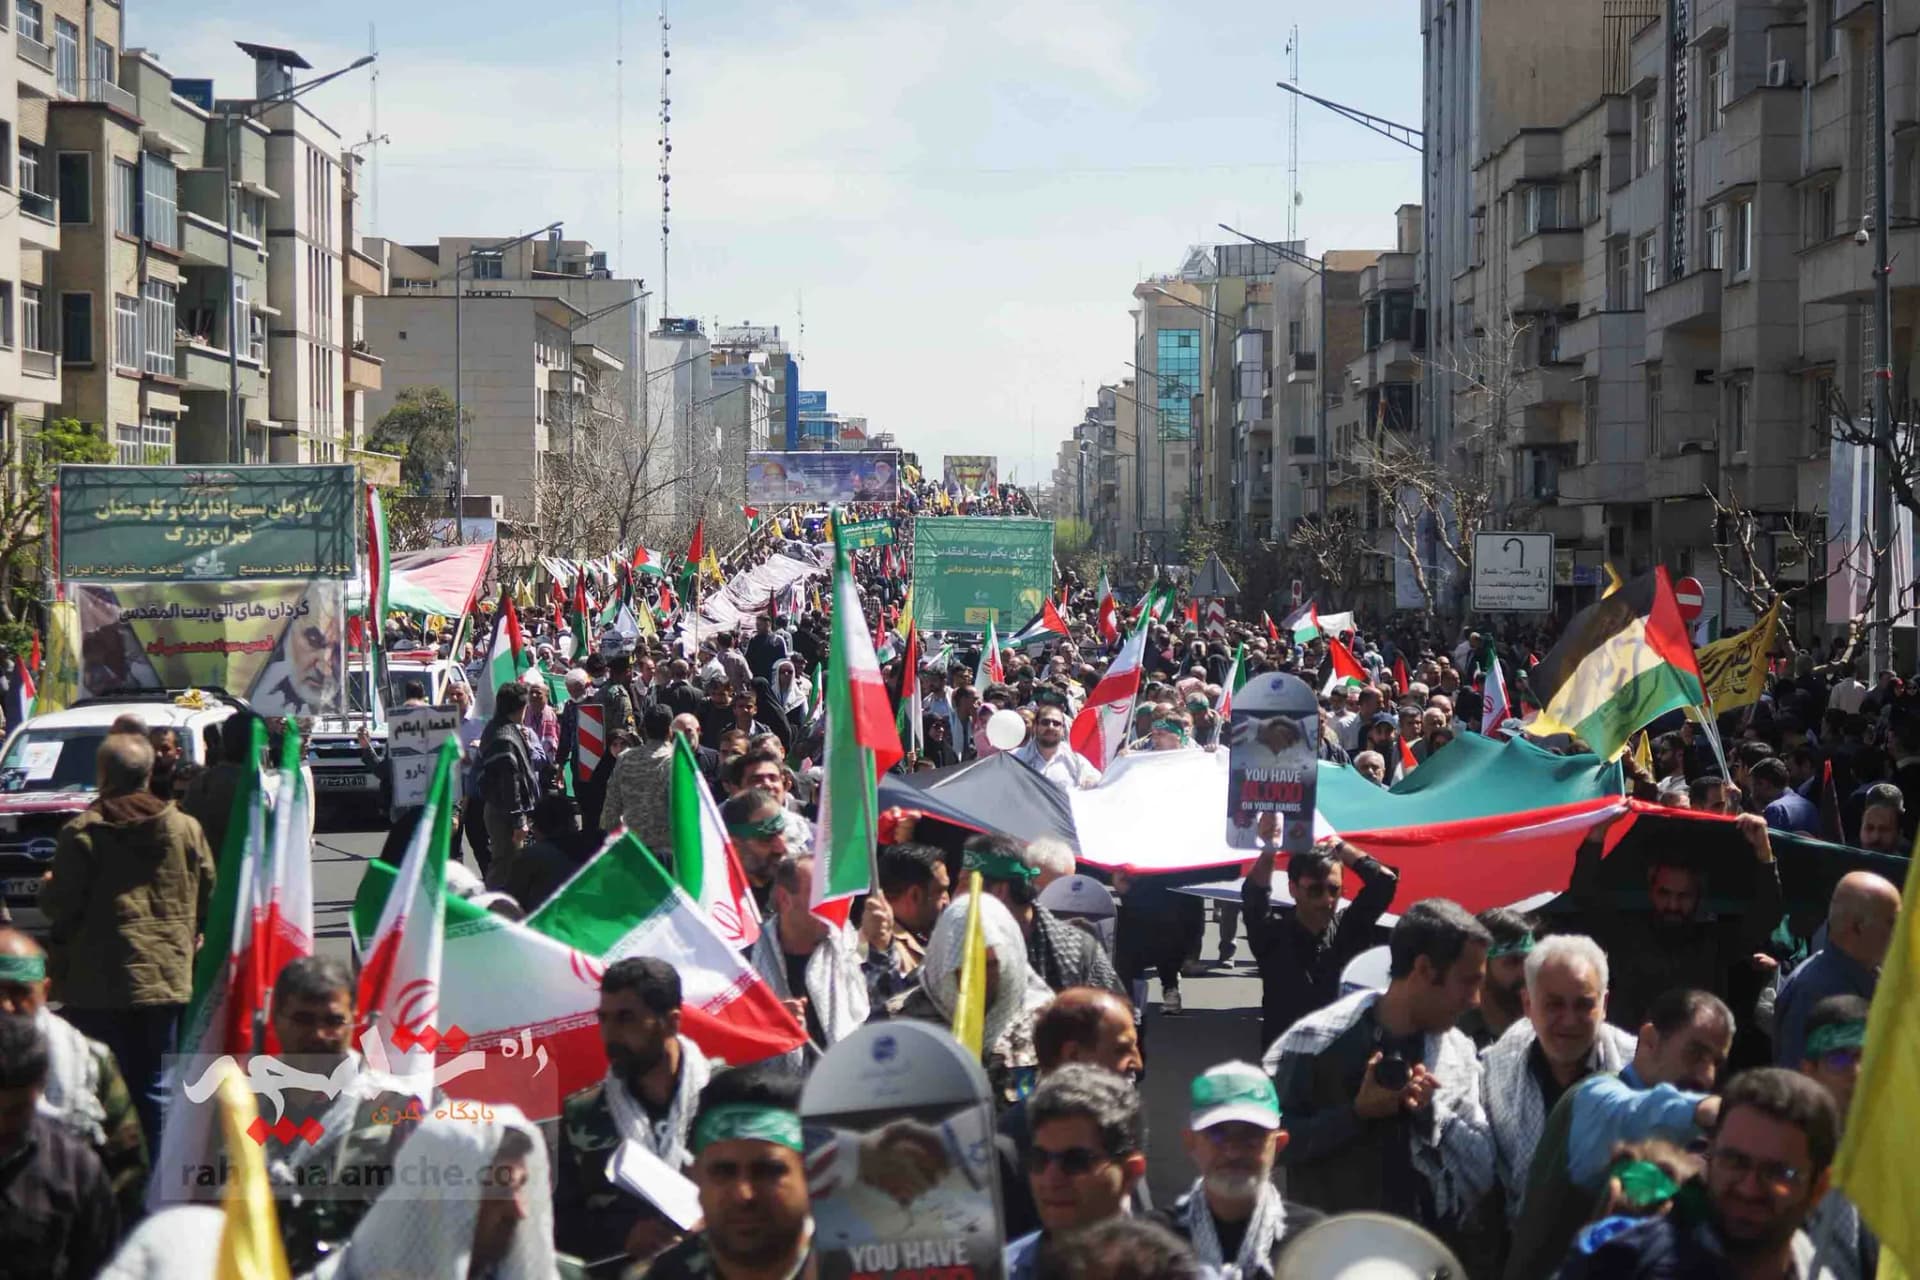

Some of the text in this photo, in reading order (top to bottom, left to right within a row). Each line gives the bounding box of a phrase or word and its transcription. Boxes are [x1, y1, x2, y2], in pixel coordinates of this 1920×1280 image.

[95, 497, 322, 521] سازمان بسیج ادارات و کارمندان
[165, 524, 252, 547] تهران بزرگ
[64, 560, 185, 577] شرکت مخابرات ایران
[239, 561, 351, 576] حوزه مقاومت بسیج
[119, 602, 179, 622] المقدس
[181, 606, 209, 622] بیت
[235, 601, 266, 621] های
[268, 600, 309, 620] گردان
[1246, 767, 1302, 783] YOU HAVE
[1240, 781, 1304, 802] BLOOD
[1254, 801, 1274, 811] YOUR
[1275, 802, 1302, 812] HANDS
[848, 1238, 969, 1273] YOU HAVE
